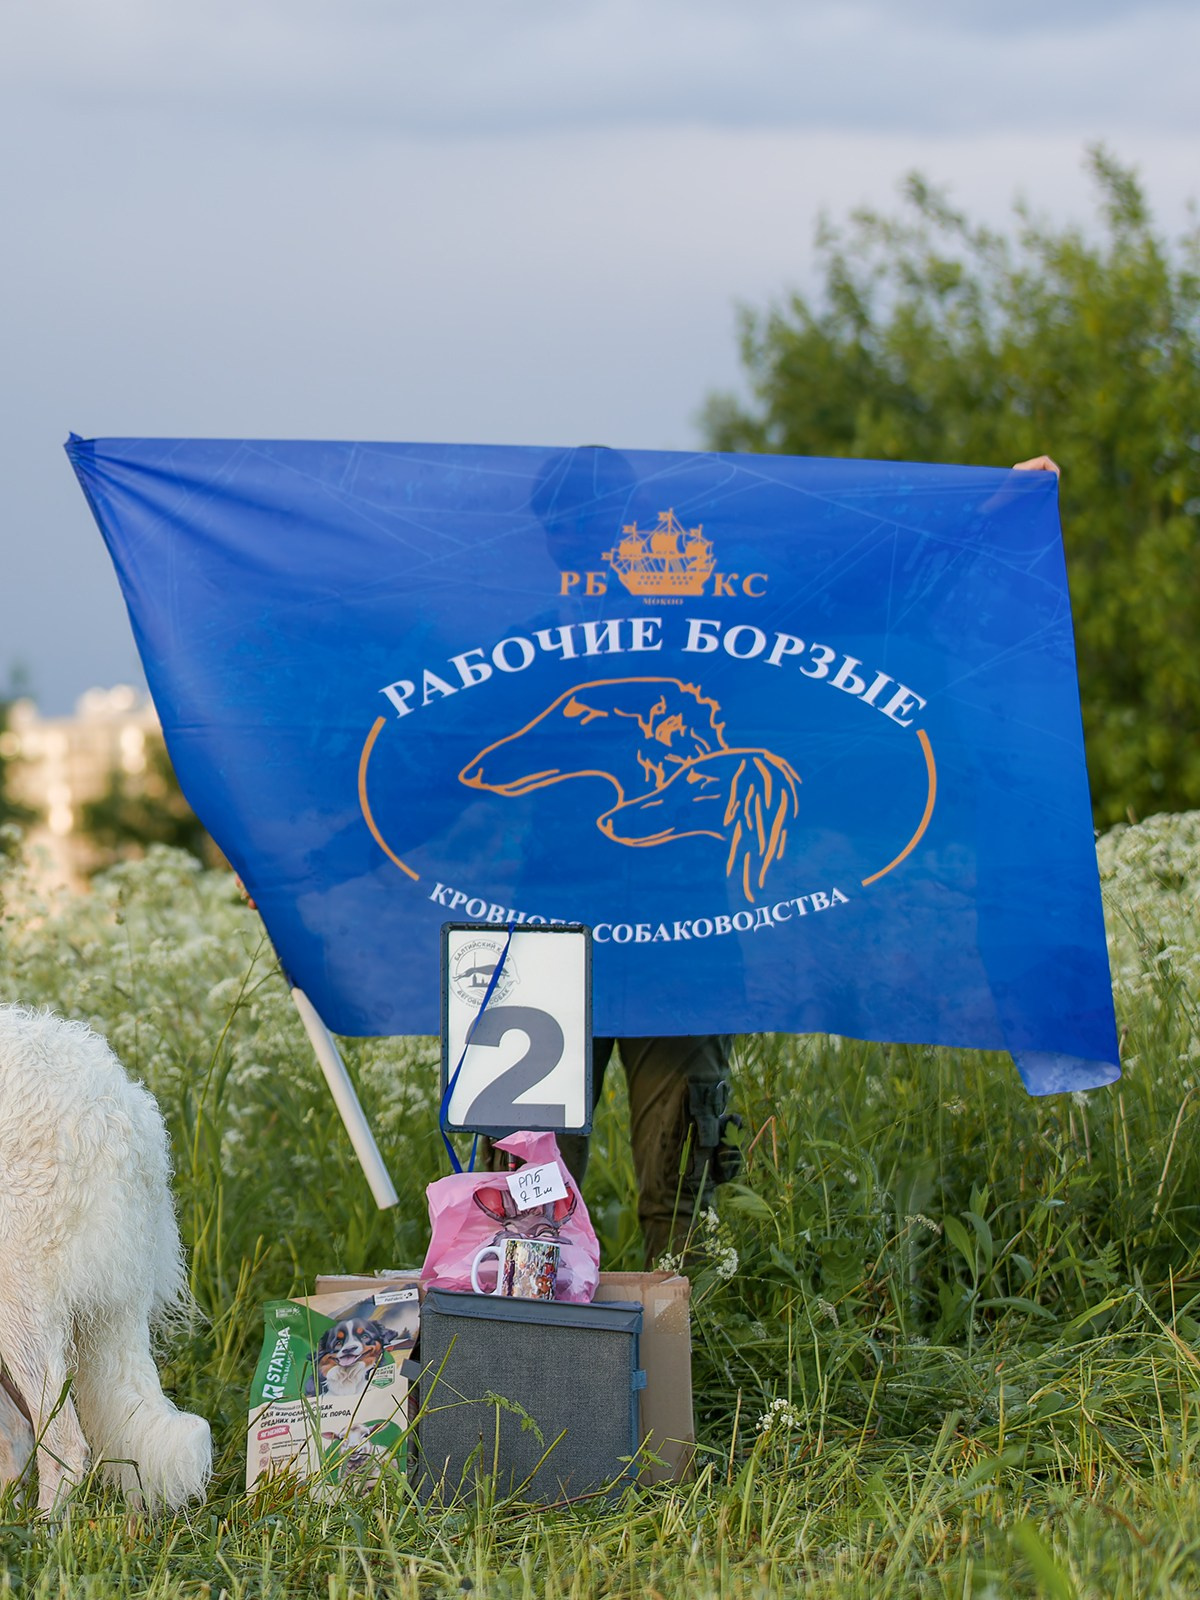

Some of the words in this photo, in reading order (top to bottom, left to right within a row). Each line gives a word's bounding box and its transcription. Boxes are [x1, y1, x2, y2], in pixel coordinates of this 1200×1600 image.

[559, 571, 608, 596] РБ
[712, 573, 769, 598] КС
[378, 617, 663, 719] РАБОЧИЕ
[681, 618, 927, 728] БОРЗЫЕ
[428, 882, 582, 925] КРОВН
[592, 887, 850, 944] СОБАКОВОДСТВА
[454, 940, 497, 961] БАЛТИЙСКИЙ
[457, 989, 482, 1006] БЕГОВЫ
[463, 1005, 566, 1128] 2
[266, 1326, 291, 1383] STATERA
[312, 1403, 334, 1412] СБАК
